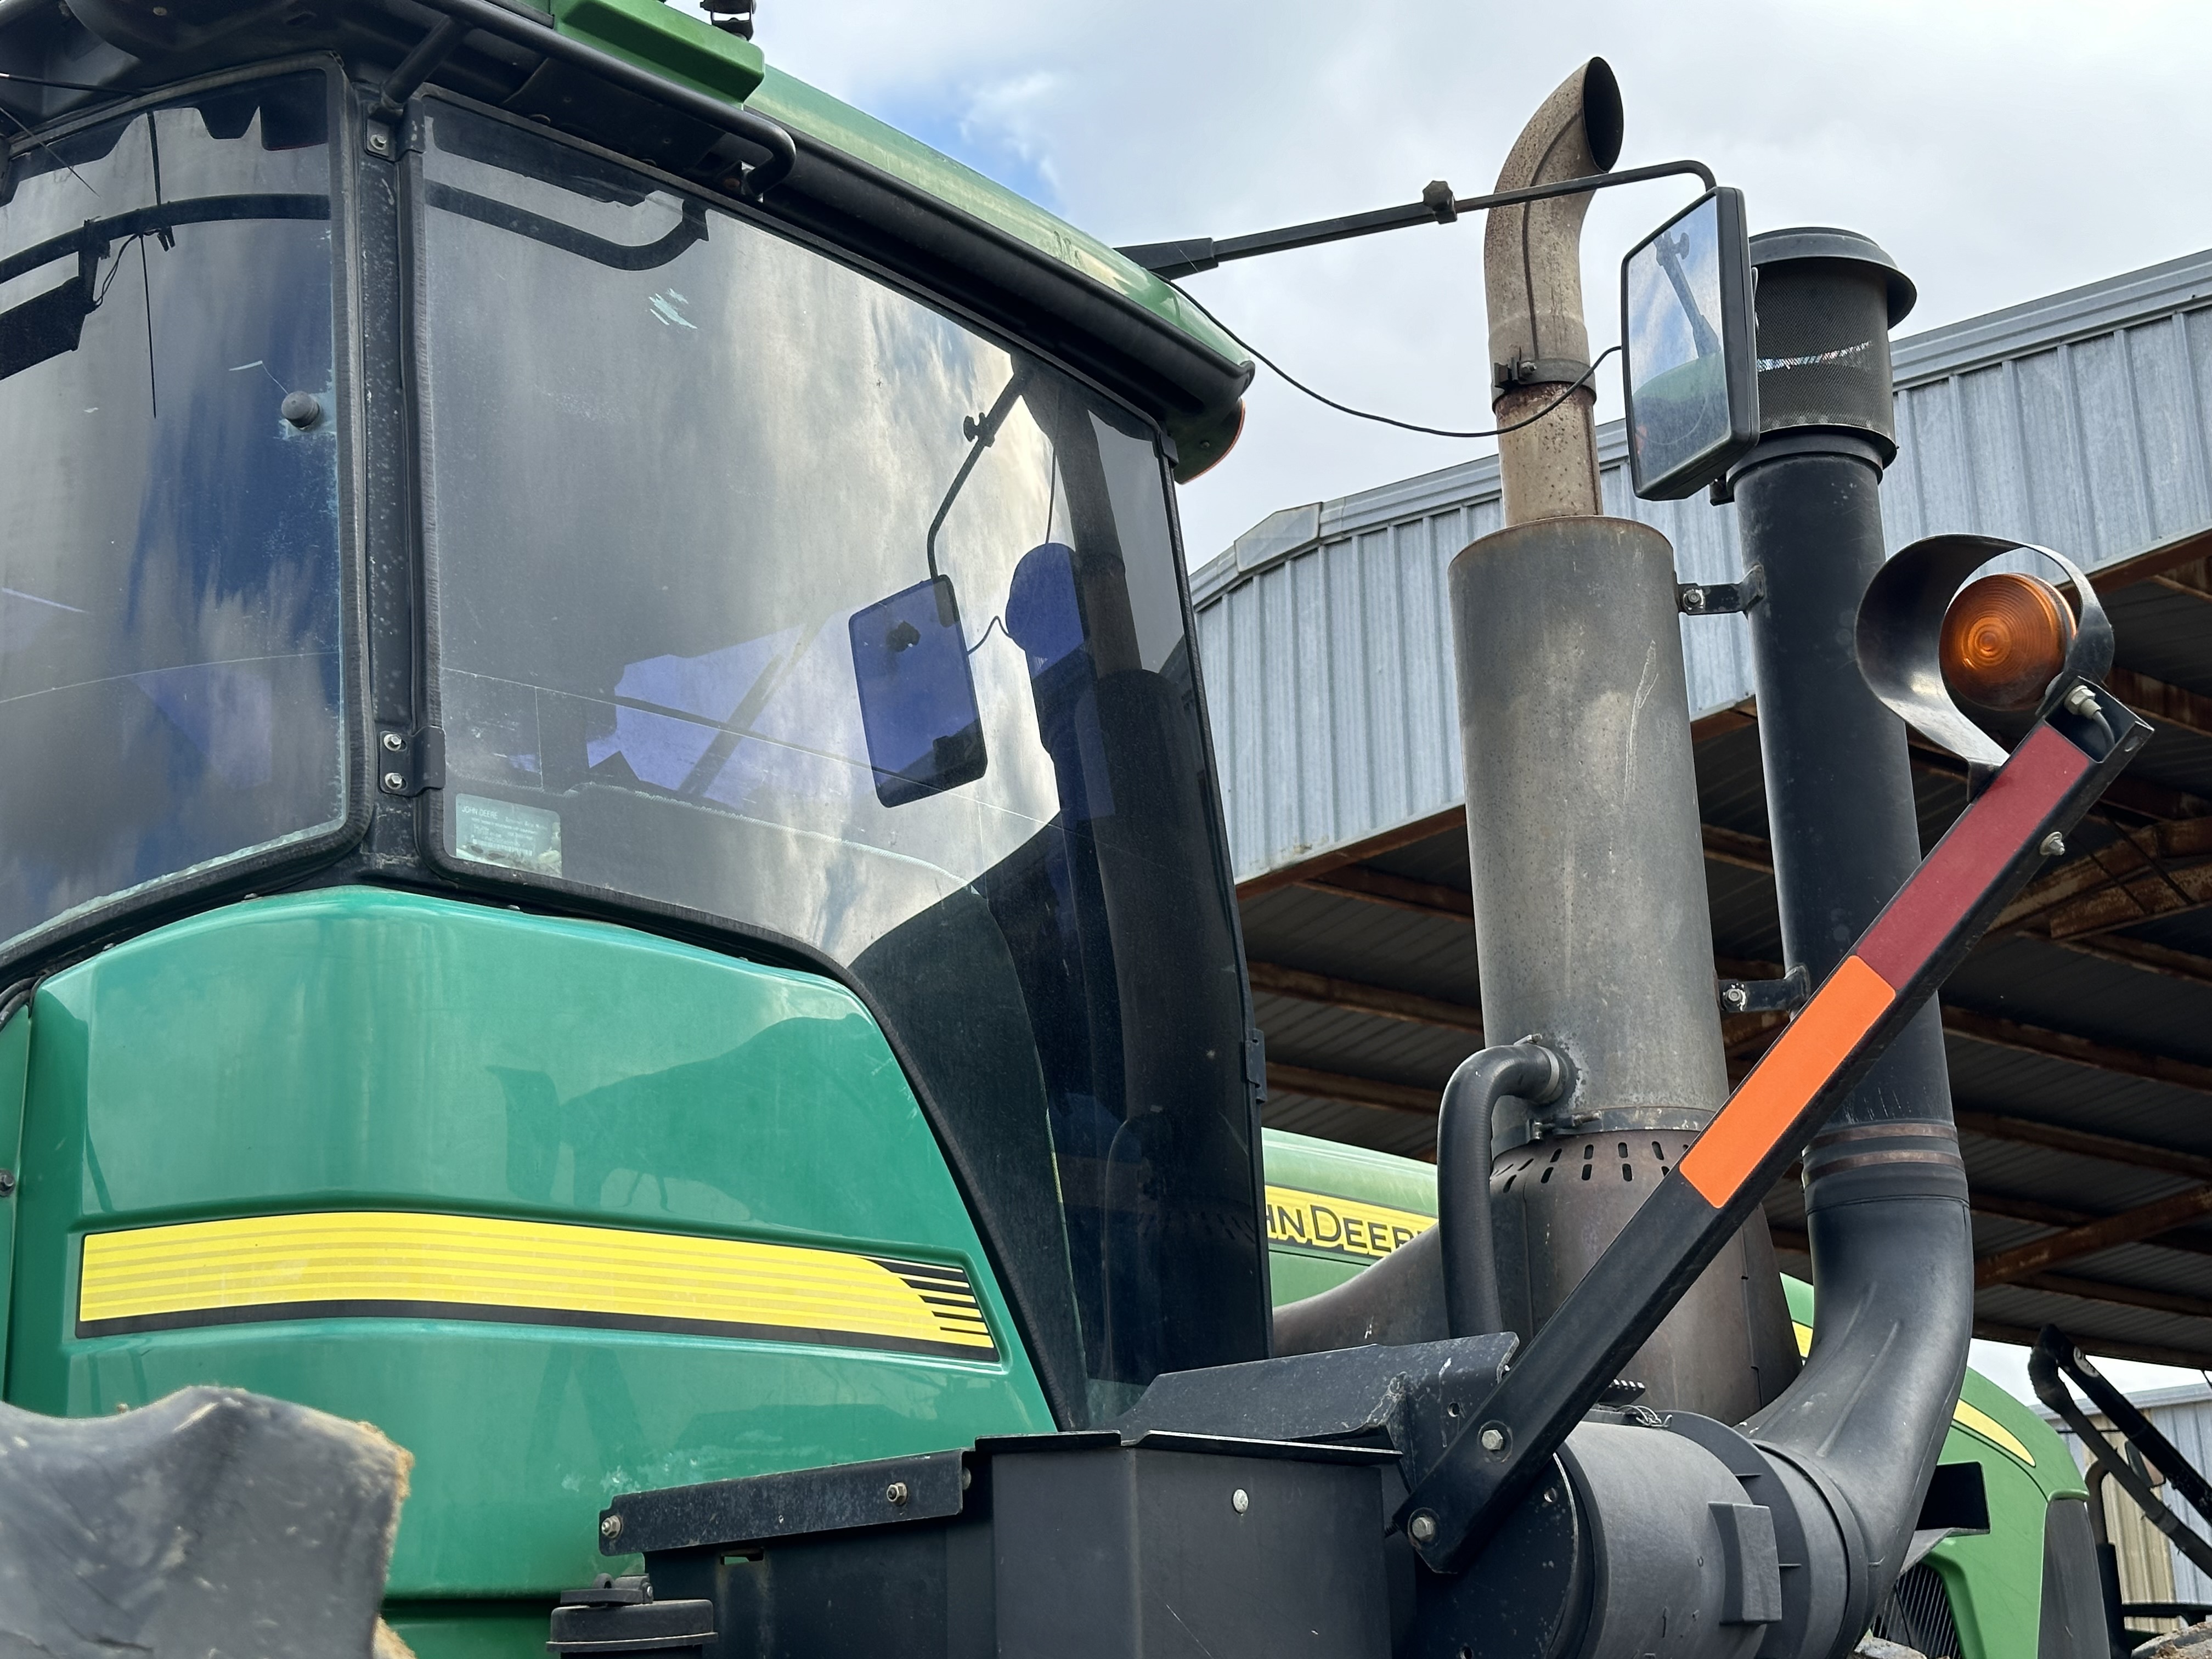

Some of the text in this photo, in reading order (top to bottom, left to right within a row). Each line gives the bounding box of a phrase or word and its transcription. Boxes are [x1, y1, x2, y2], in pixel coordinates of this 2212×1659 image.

[461, 805, 498, 820] JOHN DEERE
[1310, 1205, 1426, 1252] DEER
